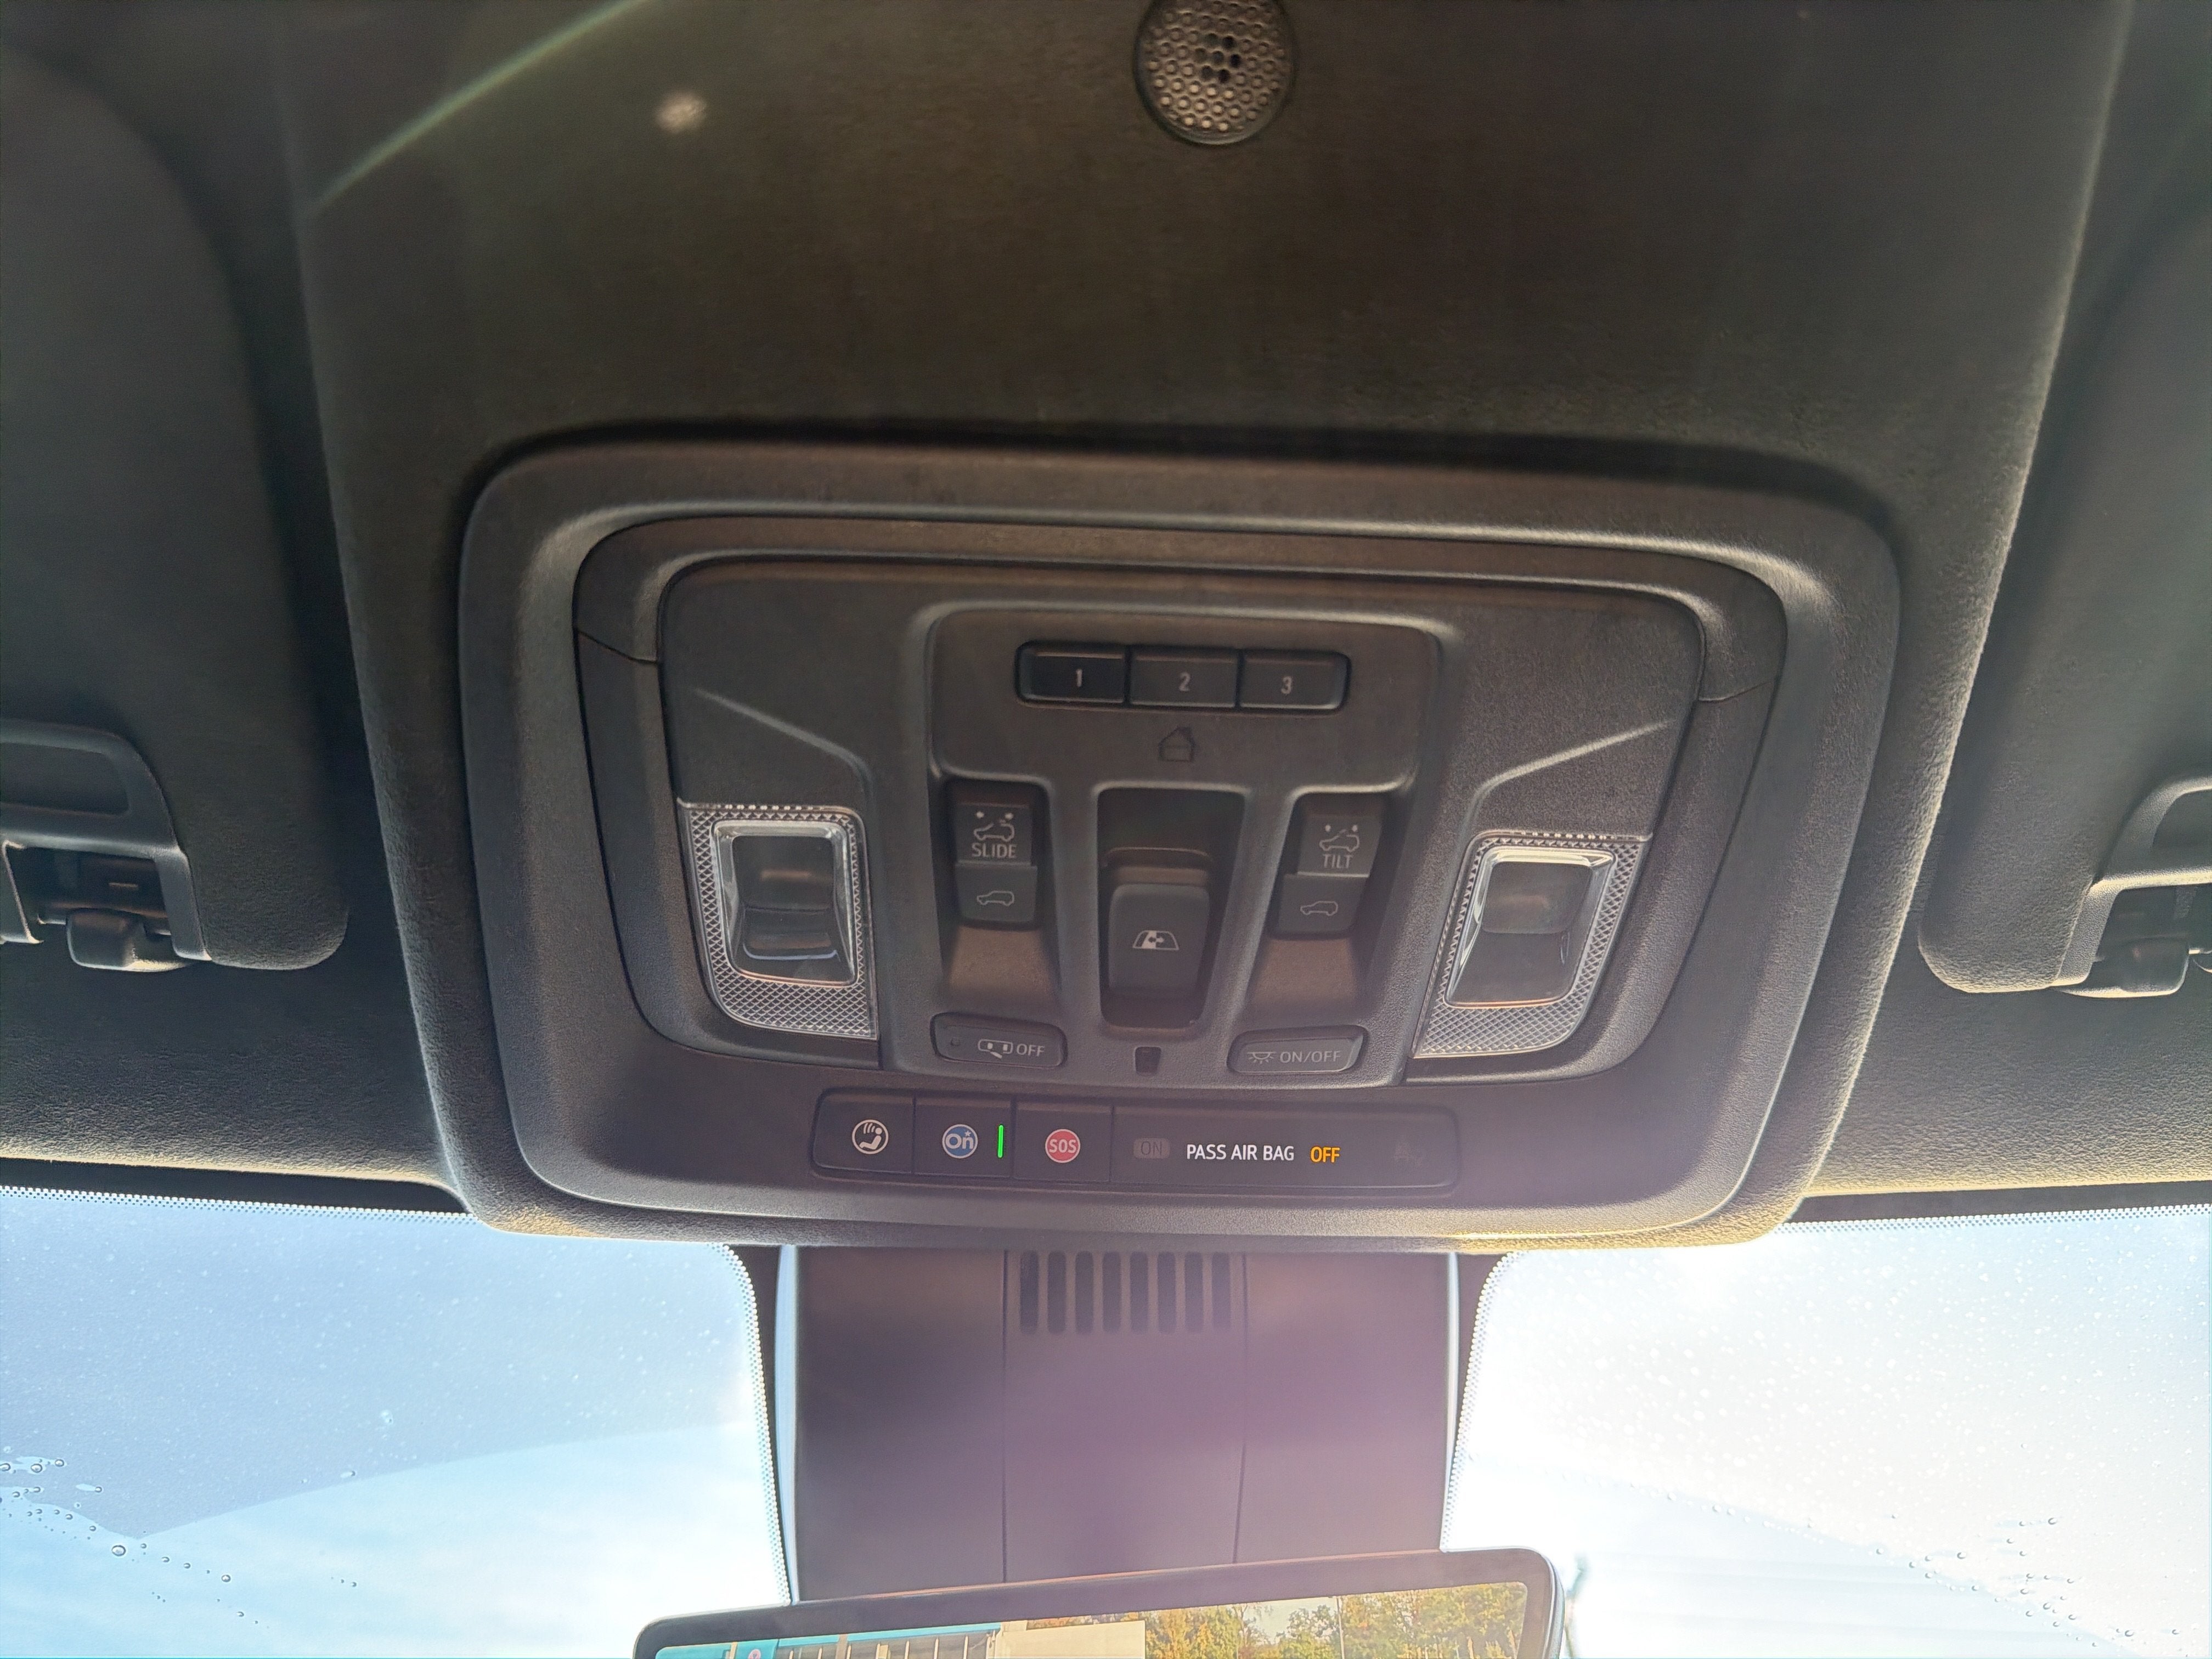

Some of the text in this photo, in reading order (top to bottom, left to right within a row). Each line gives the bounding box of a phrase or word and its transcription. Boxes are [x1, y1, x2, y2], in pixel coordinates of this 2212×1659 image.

[1075, 668, 1083, 687] 1
[1178, 672, 1191, 692] 2
[1280, 676, 1293, 695] 3
[972, 842, 1017, 859] SLIDE
[1323, 854, 1353, 868] TILT
[1016, 1043, 1045, 1057] OFF
[1279, 1051, 1341, 1063] ON/OFF
[945, 1133, 974, 1150] On
[1048, 1139, 1077, 1154] SOS
[1186, 1144, 1340, 1163] PASS AIR BAG OFF
